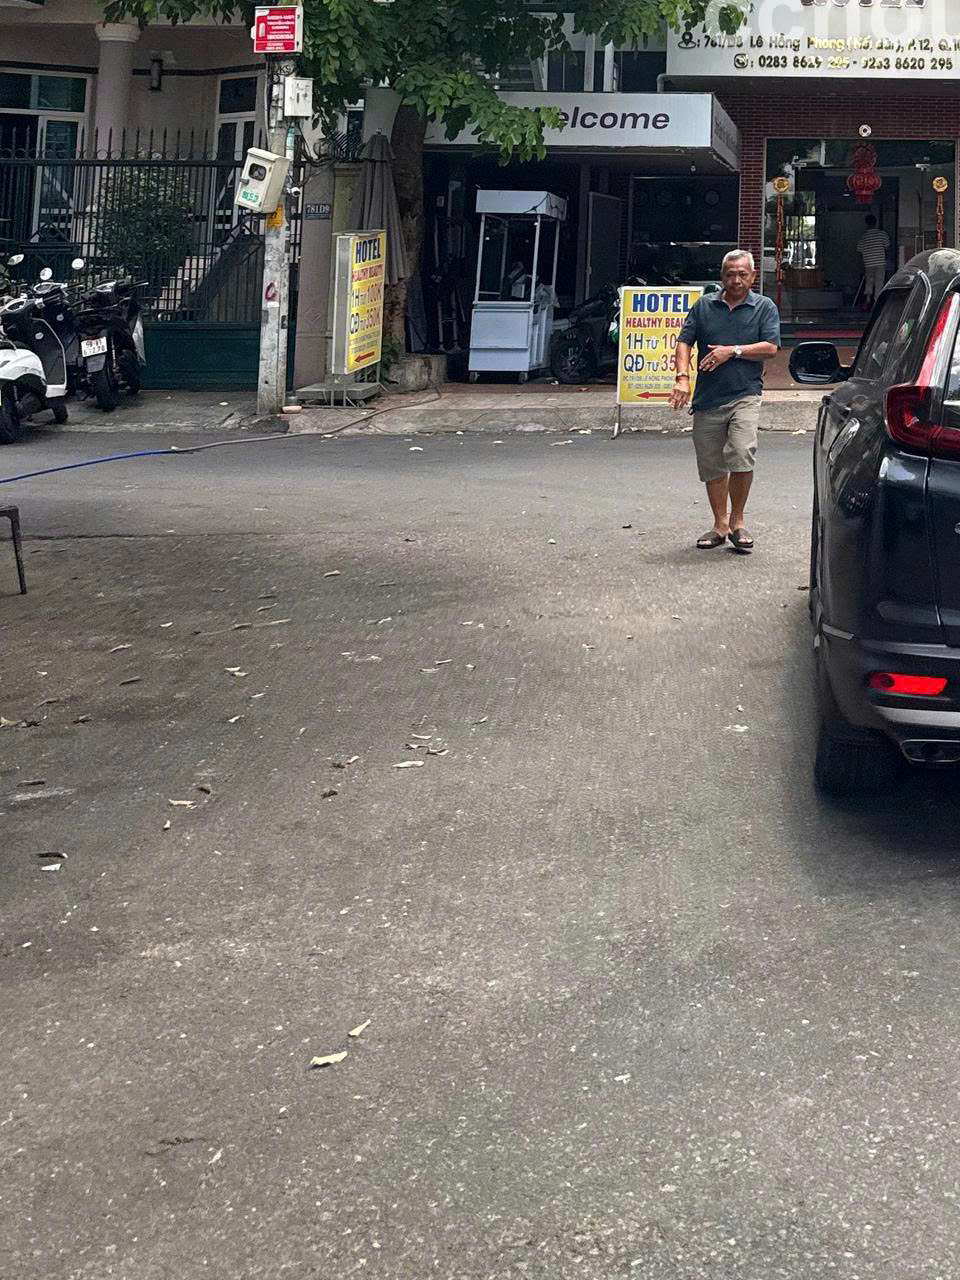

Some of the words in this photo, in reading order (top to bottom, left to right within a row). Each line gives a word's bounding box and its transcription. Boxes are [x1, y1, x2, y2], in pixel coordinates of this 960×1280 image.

[758, 55, 787, 68] 0283
[895, 57, 925, 70] 8620
[930, 58, 953, 70] 295
[535, 106, 670, 130] elcome
[355, 238, 381, 263] HOTEL
[632, 293, 690, 313] HOTEL
[625, 317, 662, 328] HEALTHY
[626, 333, 644, 350] 1H
[623, 354, 645, 373] QĐ
